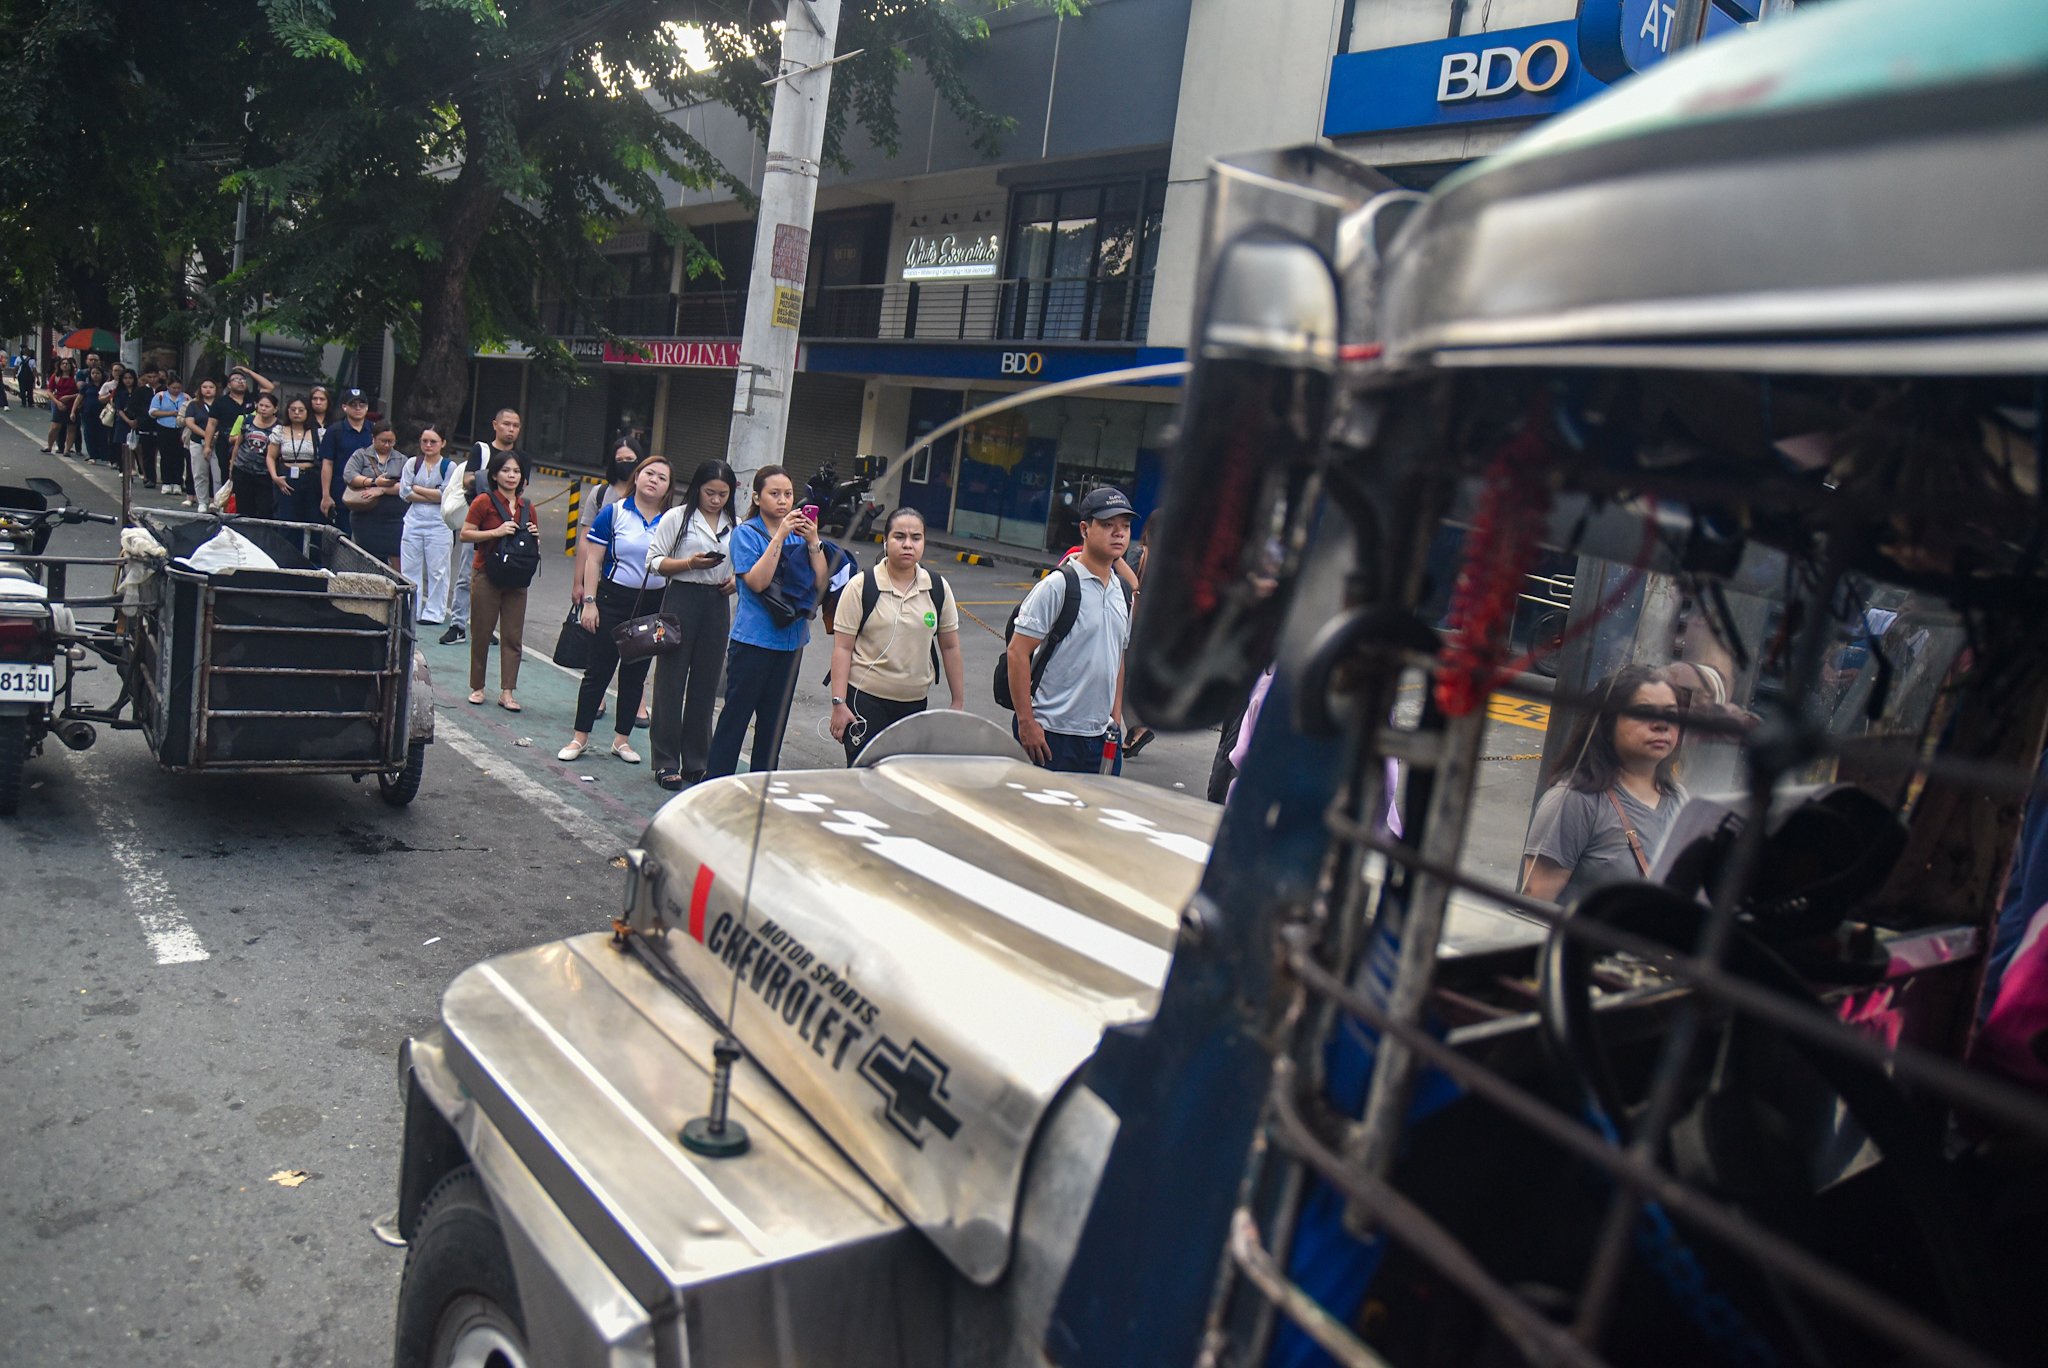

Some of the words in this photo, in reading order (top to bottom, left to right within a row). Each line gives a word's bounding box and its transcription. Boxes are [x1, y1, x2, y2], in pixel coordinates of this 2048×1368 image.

[1640, 0, 1675, 52] AT
[1437, 39, 1569, 101] BDO
[939, 233, 998, 266] Essentials
[1001, 352, 1042, 374] BDO
[0, 672, 49, 692] 813U
[708, 911, 863, 1072] CHEVROLET
[758, 919, 815, 970] MOTOR
[810, 963, 880, 1025] SPORTS
